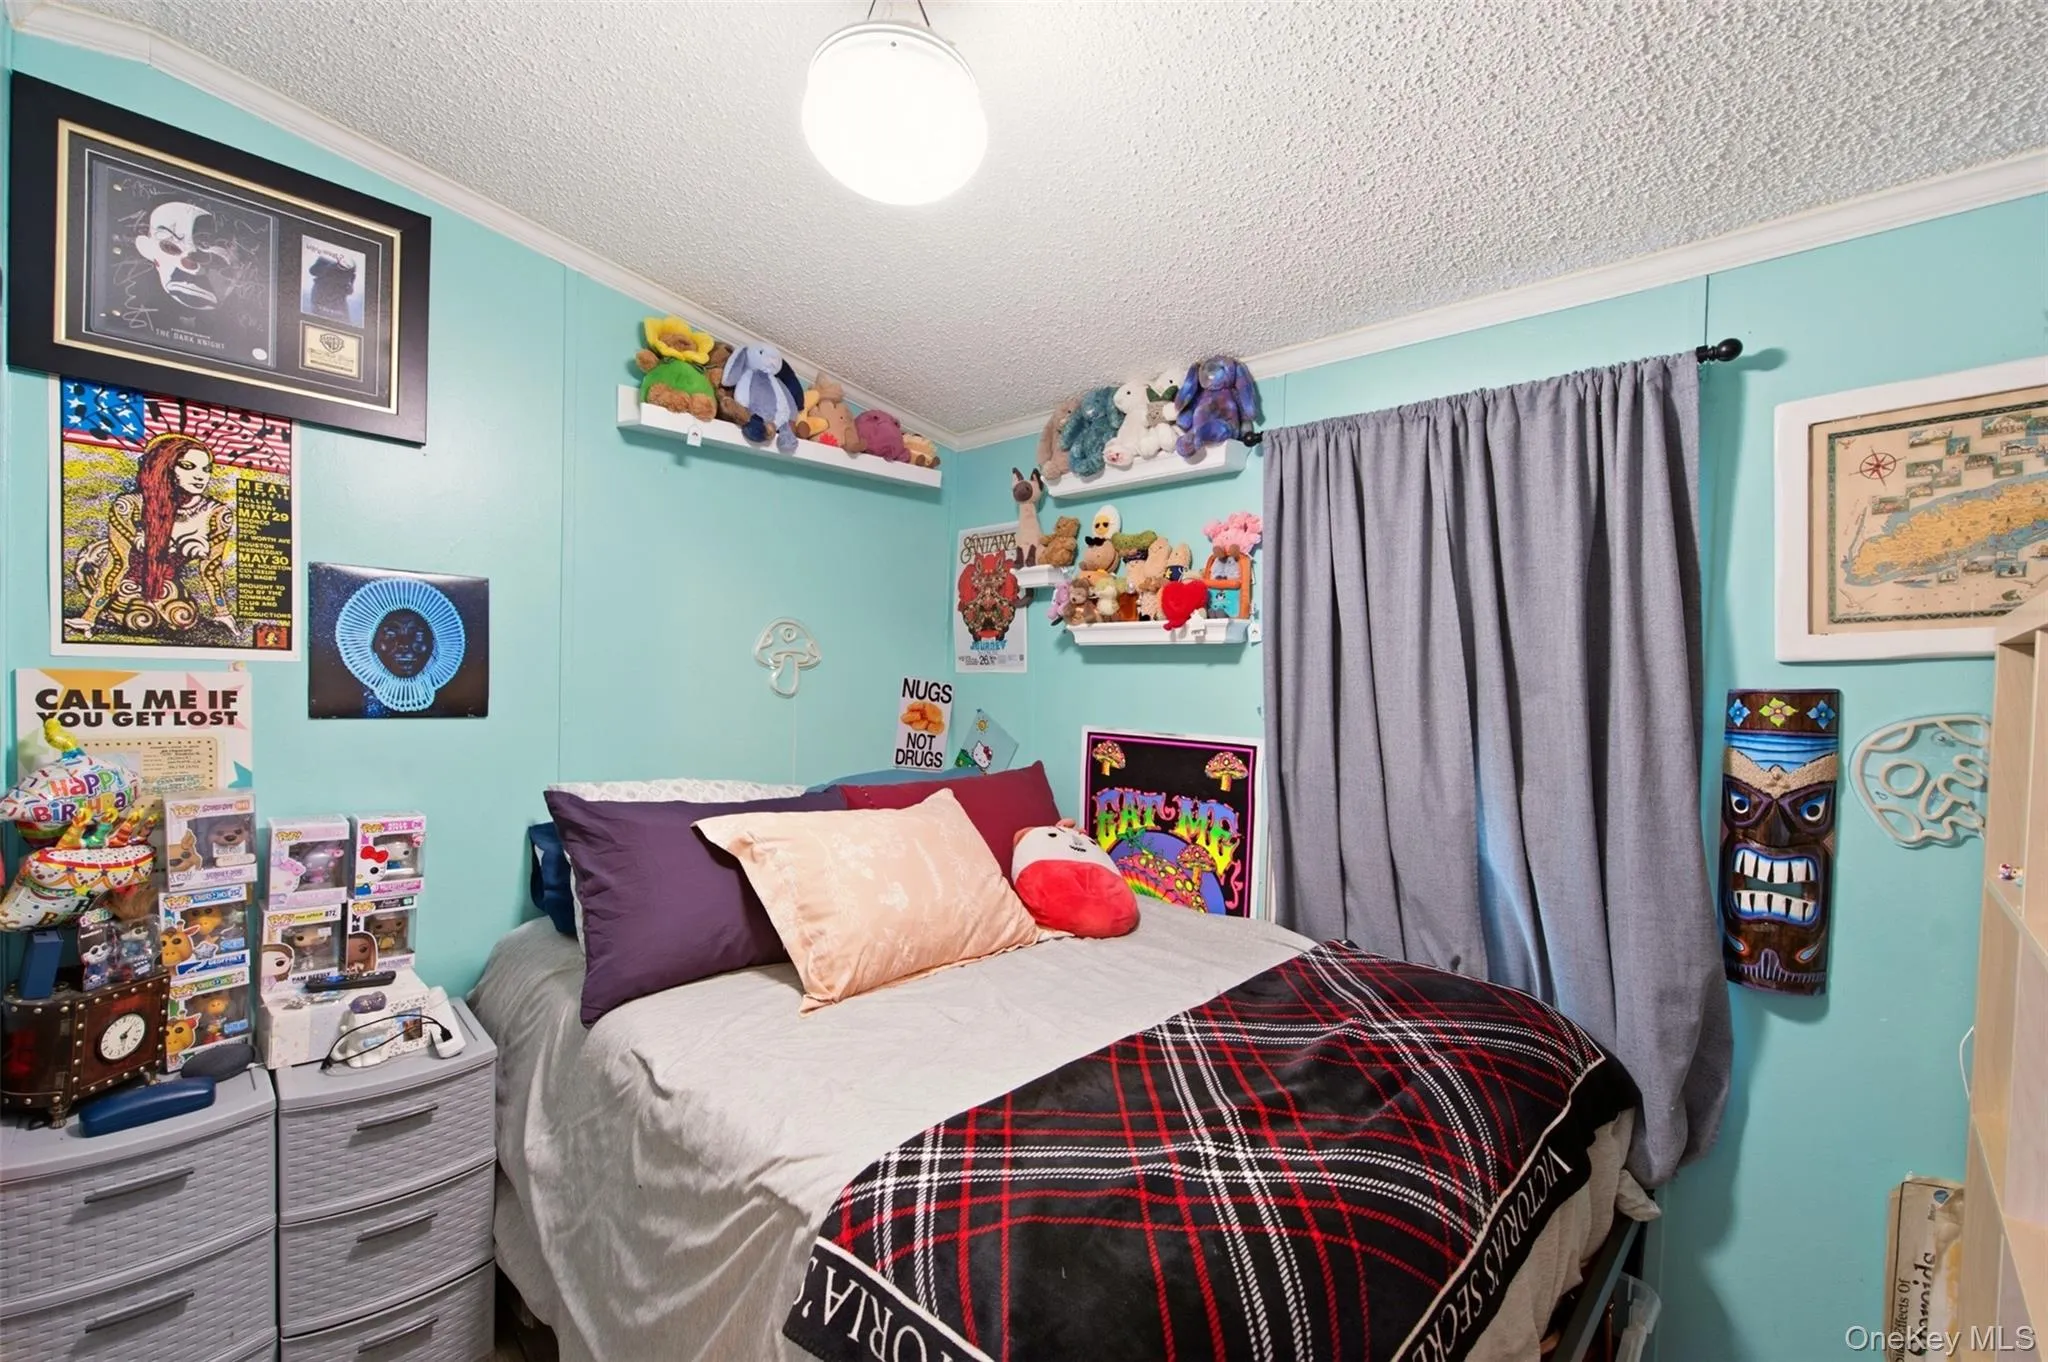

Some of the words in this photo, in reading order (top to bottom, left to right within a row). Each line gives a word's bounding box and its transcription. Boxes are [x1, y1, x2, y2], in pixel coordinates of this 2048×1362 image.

[173, 332, 194, 344] DARK
[197, 338, 225, 349] KNIGHT
[238, 480, 290, 494] MEAT
[238, 509, 270, 520] MAY
[272, 512, 289, 522] 29
[960, 532, 1017, 564] SANTANA
[238, 553, 269, 564] MAY
[271, 556, 289, 566] 30
[35, 689, 132, 710] CALL
[142, 690, 197, 710] ME
[208, 690, 238, 709] IF
[902, 678, 952, 704] NUGS
[36, 711, 103, 728] YOU
[112, 711, 166, 727] GET
[173, 711, 238, 726] LOST
[906, 732, 936, 750] NOT
[895, 748, 943, 768] DRUGS
[1093, 787, 1174, 853] EAT
[1170, 795, 1241, 877] ME
[1484, 1146, 1573, 1296] VICTORIA'S
[1897, 1278, 1911, 1294] Of
